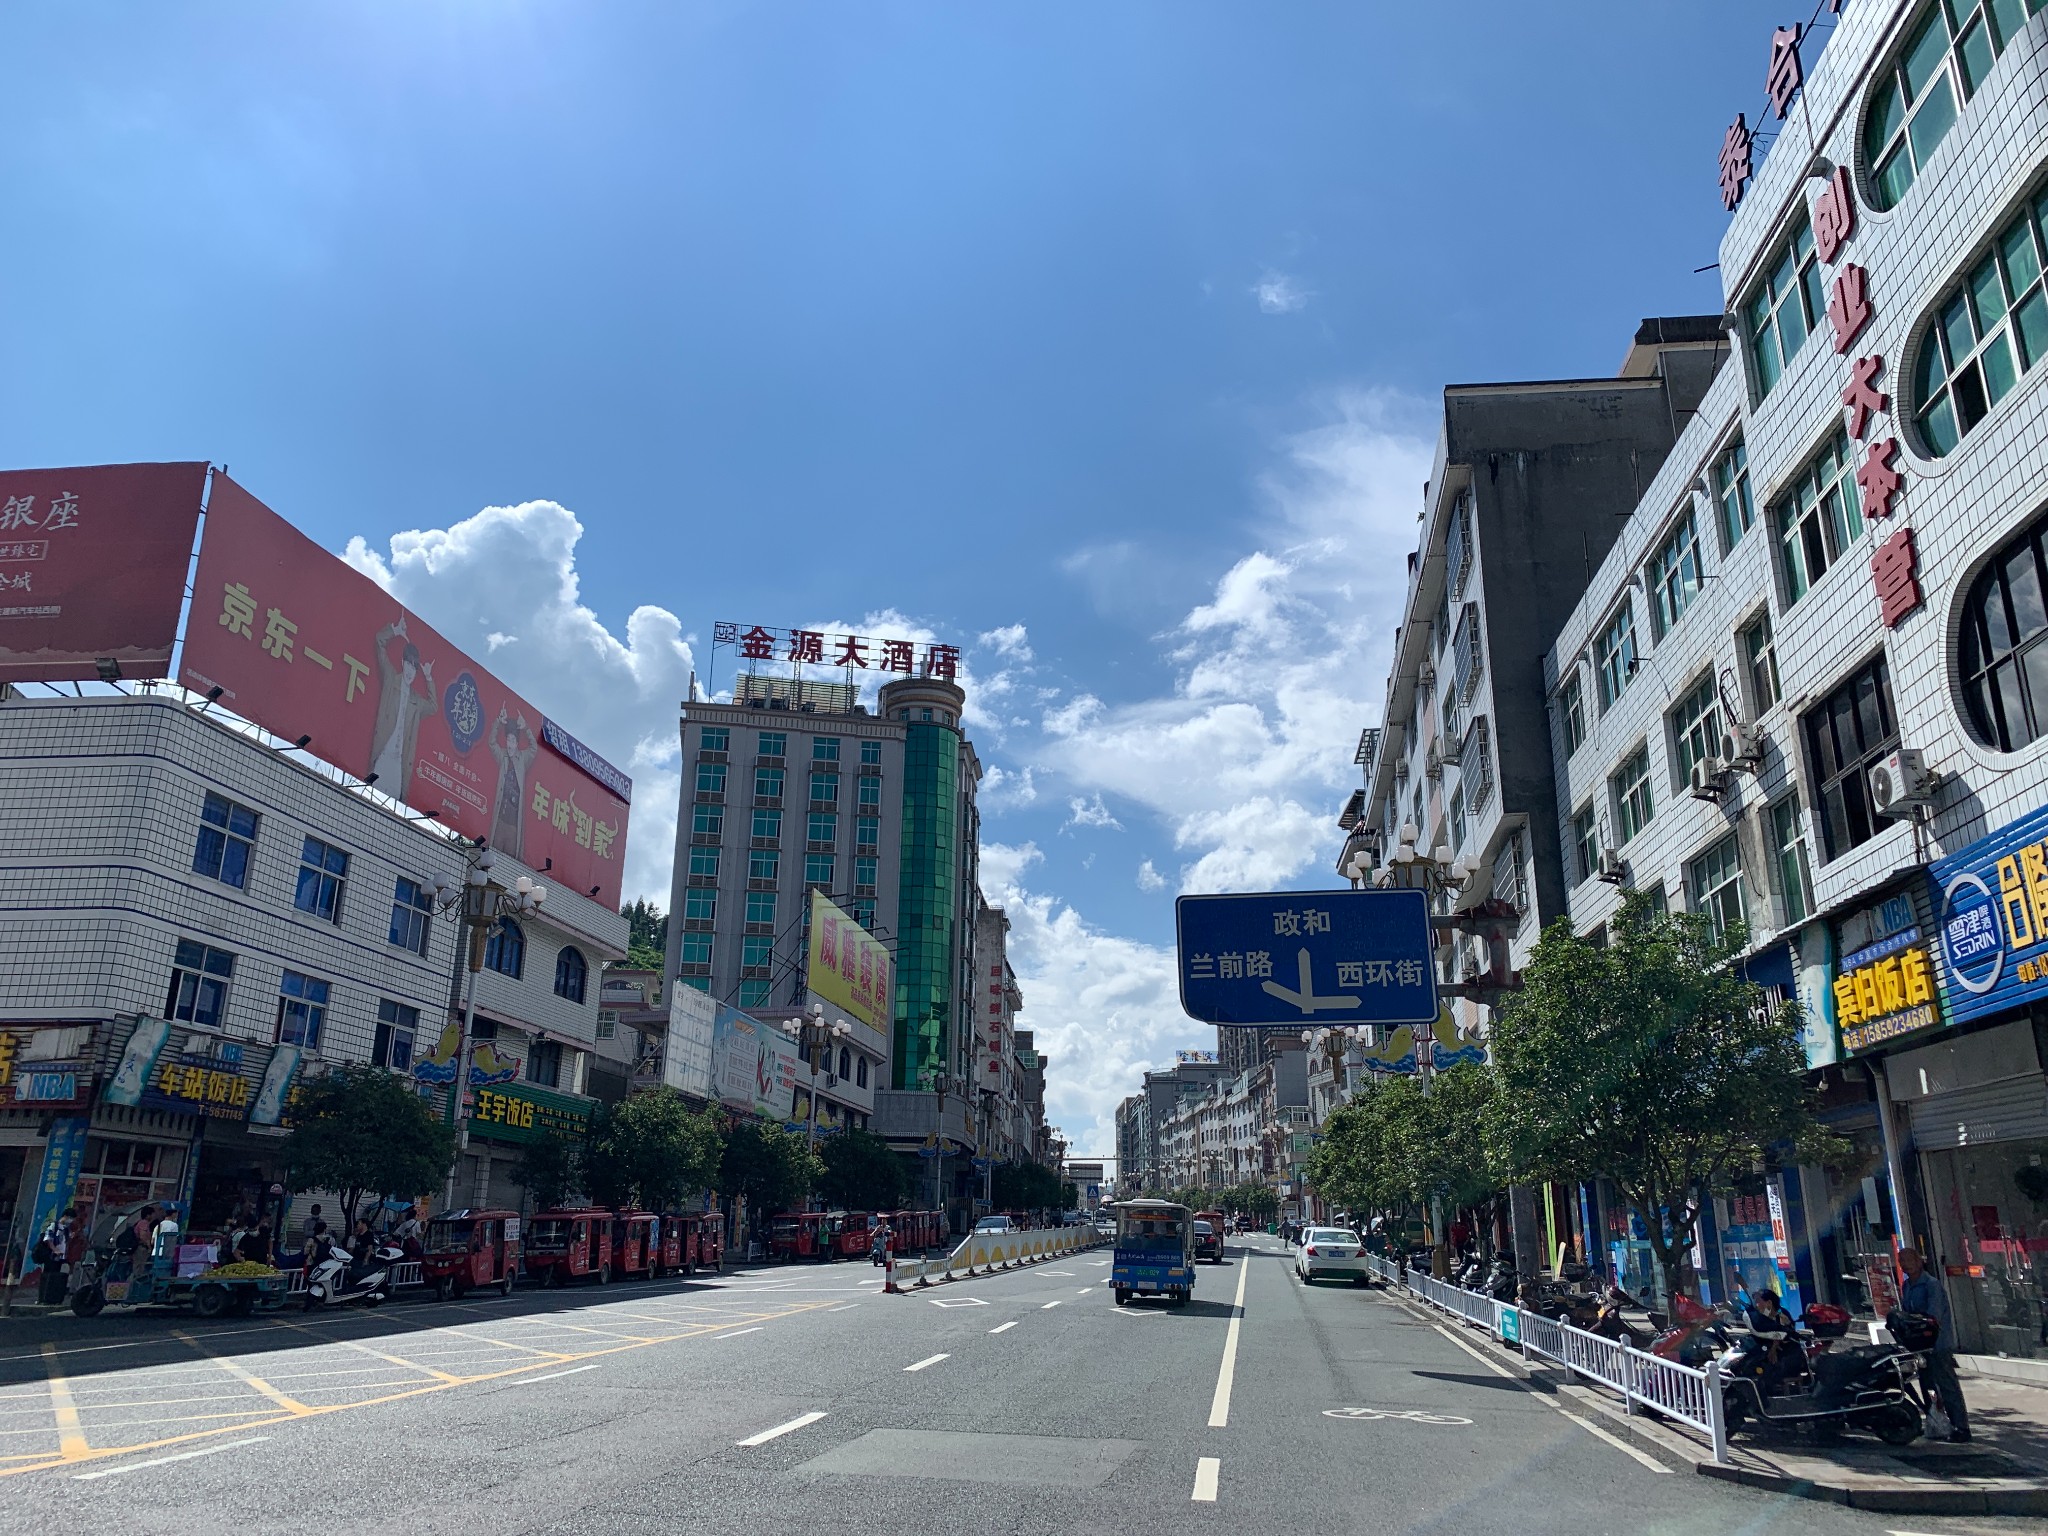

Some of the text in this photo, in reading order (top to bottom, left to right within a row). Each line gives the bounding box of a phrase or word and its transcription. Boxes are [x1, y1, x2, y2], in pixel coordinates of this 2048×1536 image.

[1814, 165, 1926, 629] 创业大本营
[218, 582, 371, 703] 京东一下
[741, 626, 960, 678] 金源大酒店
[546, 720, 571, 756] 招租
[531, 781, 619, 860] 年味到家
[1272, 909, 1331, 936] 政和
[1882, 895, 1914, 934] NBA
[1948, 909, 1981, 943] 雪津
[1952, 929, 1996, 960] SEDRIN
[1190, 951, 1423, 988] 兰前路 西环街
[1833, 948, 1932, 1029] 宾归饭店
[1863, 1005, 1933, 1043] 15859234680
[28, 1072, 76, 1101] NBA
[156, 1060, 250, 1106] 车站饭店
